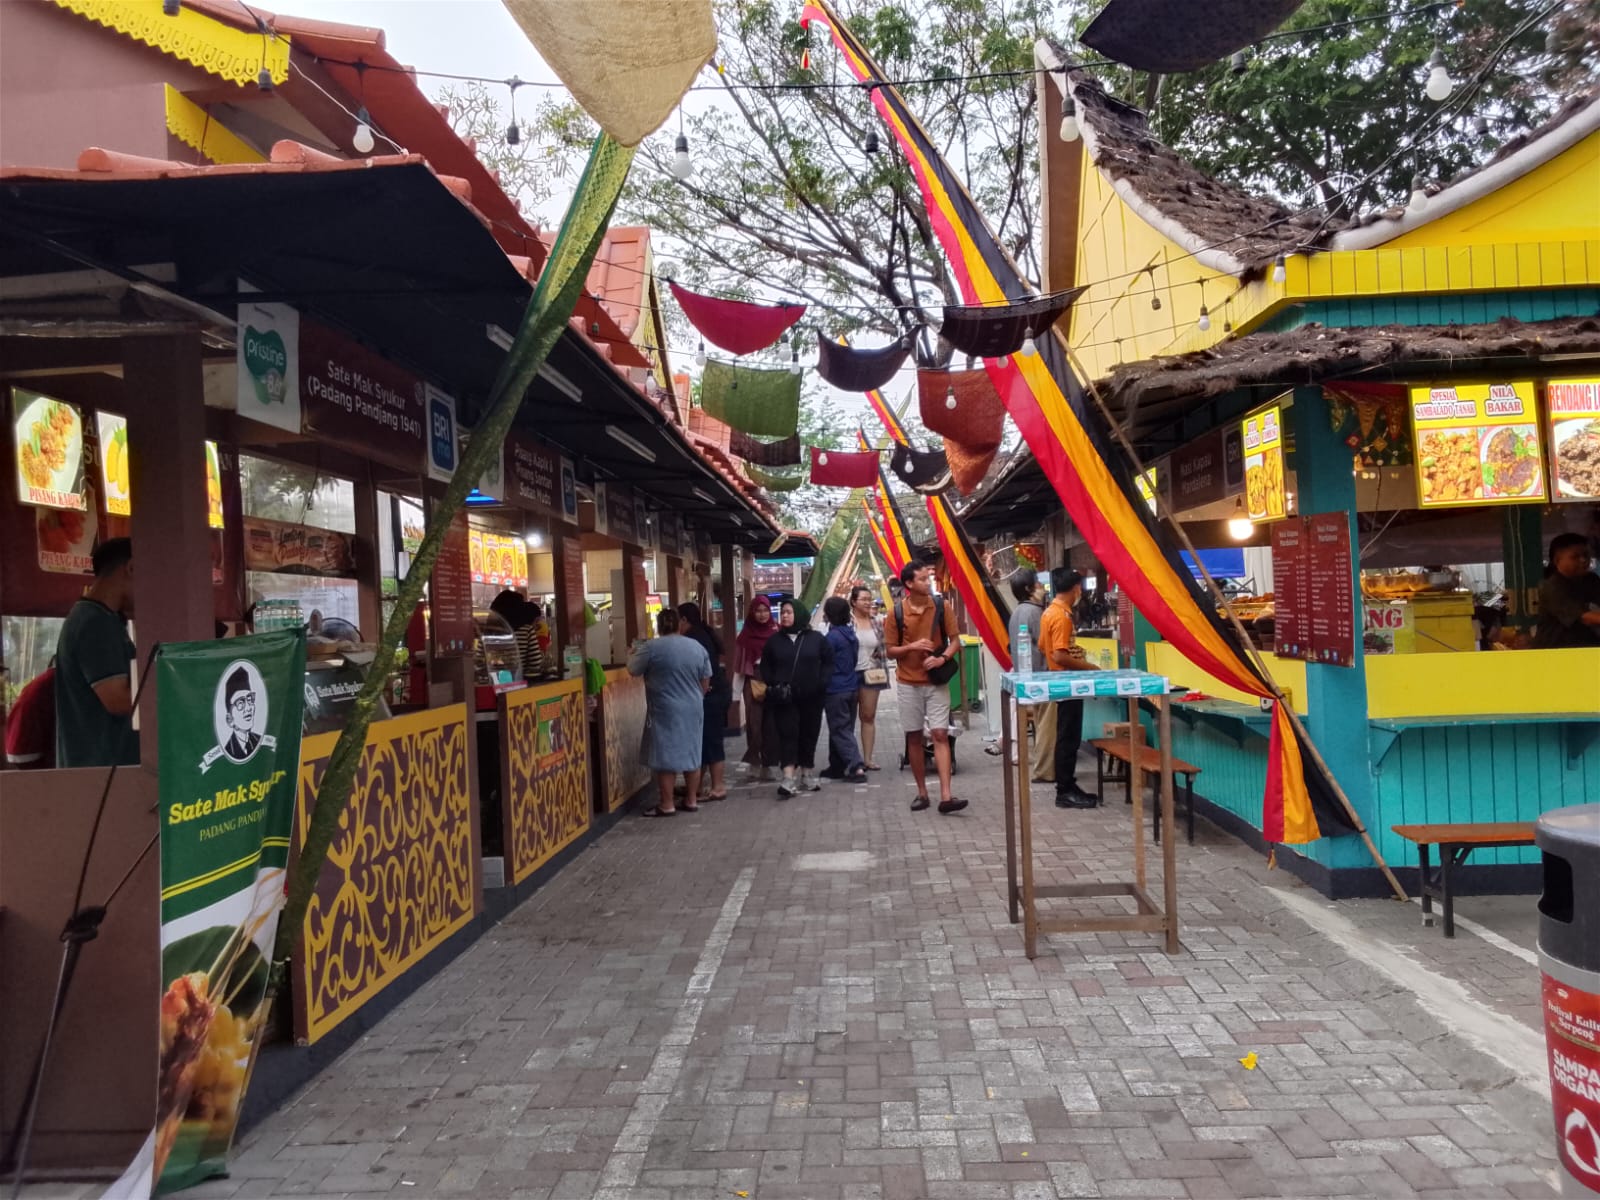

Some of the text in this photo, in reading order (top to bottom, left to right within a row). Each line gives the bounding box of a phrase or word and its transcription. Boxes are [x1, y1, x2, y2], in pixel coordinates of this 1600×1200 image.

[247, 338, 285, 366] pristine
[327, 359, 406, 411] Sate Mak Syukur
[1491, 386, 1514, 398] NILA
[1549, 384, 1592, 411] RENDANG
[308, 375, 353, 413] (Padang
[355, 395, 398, 431] Pandjang
[1487, 400, 1520, 413] BAKAR
[433, 412, 450, 443] BRI
[168, 798, 213, 825] Sate
[213, 785, 247, 812] Mak
[199, 818, 237, 842] PADANG
